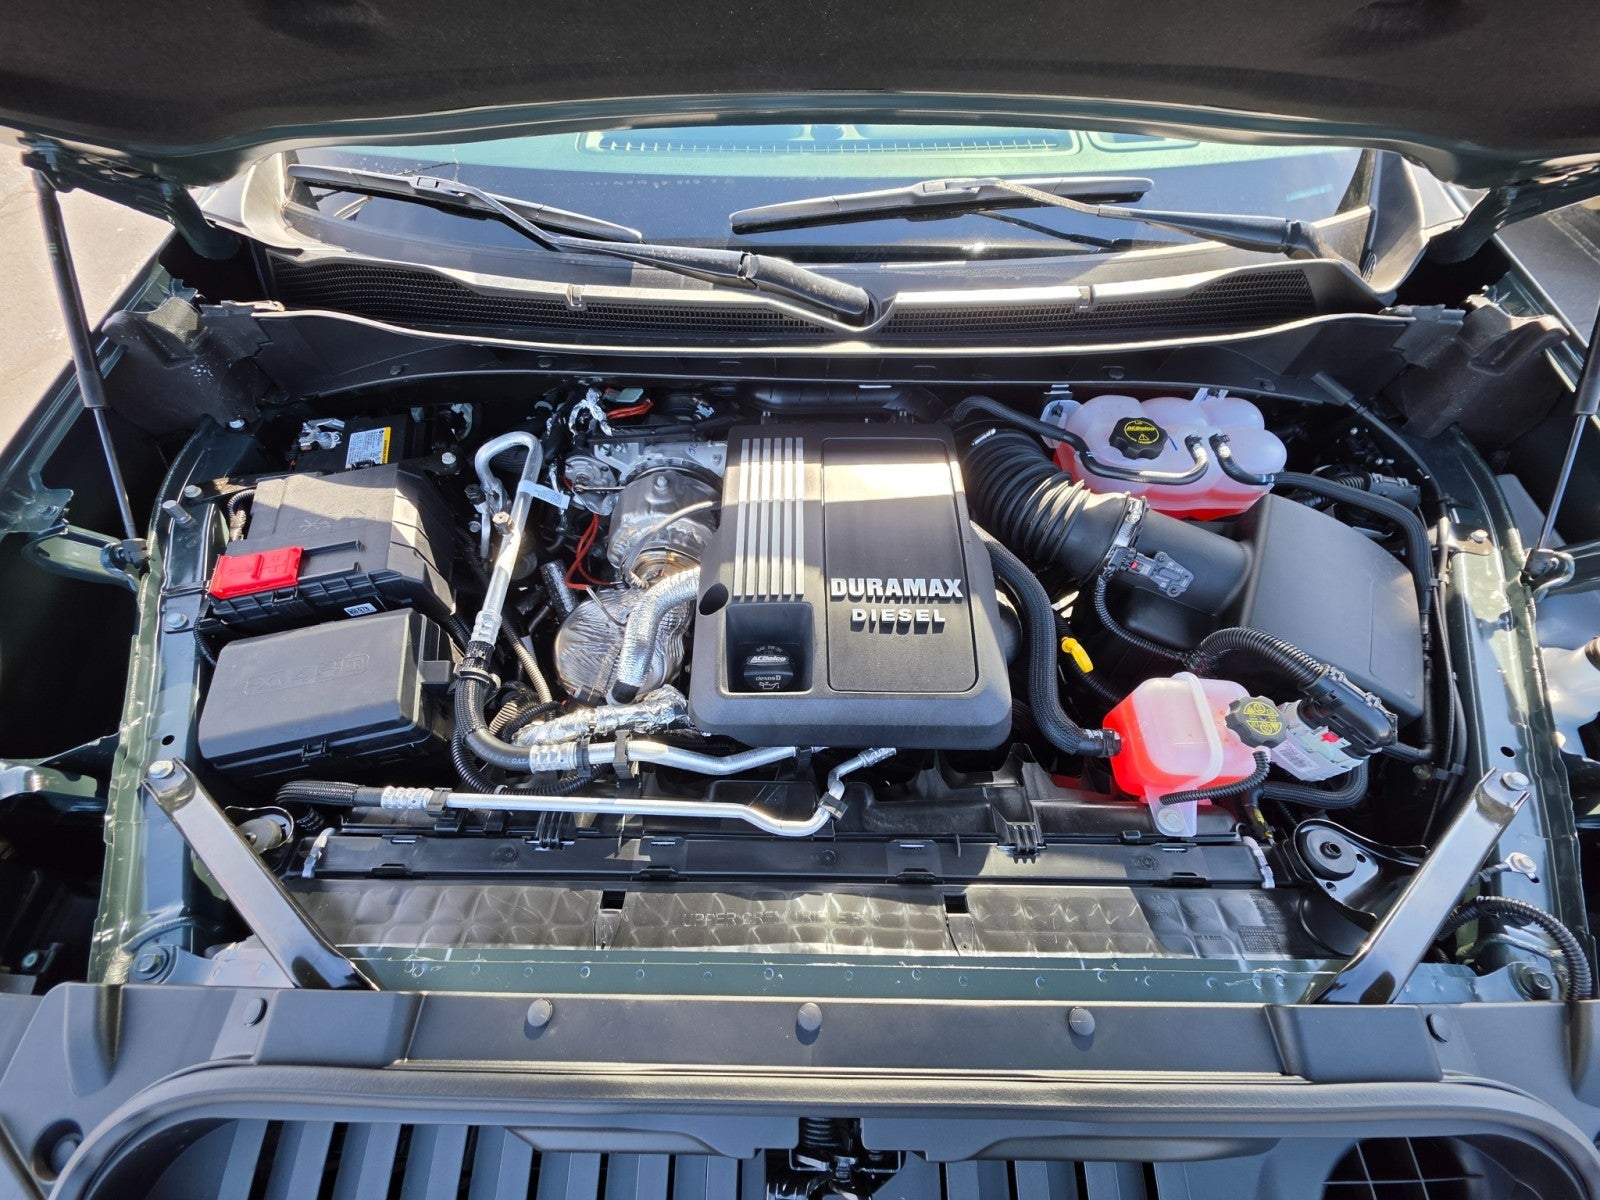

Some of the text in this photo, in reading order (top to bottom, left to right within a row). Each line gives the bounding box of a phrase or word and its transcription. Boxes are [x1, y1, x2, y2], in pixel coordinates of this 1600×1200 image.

[830, 578, 963, 597] DURAMAX
[852, 608, 945, 622] DIESEL
[750, 655, 787, 664] ACDelco
